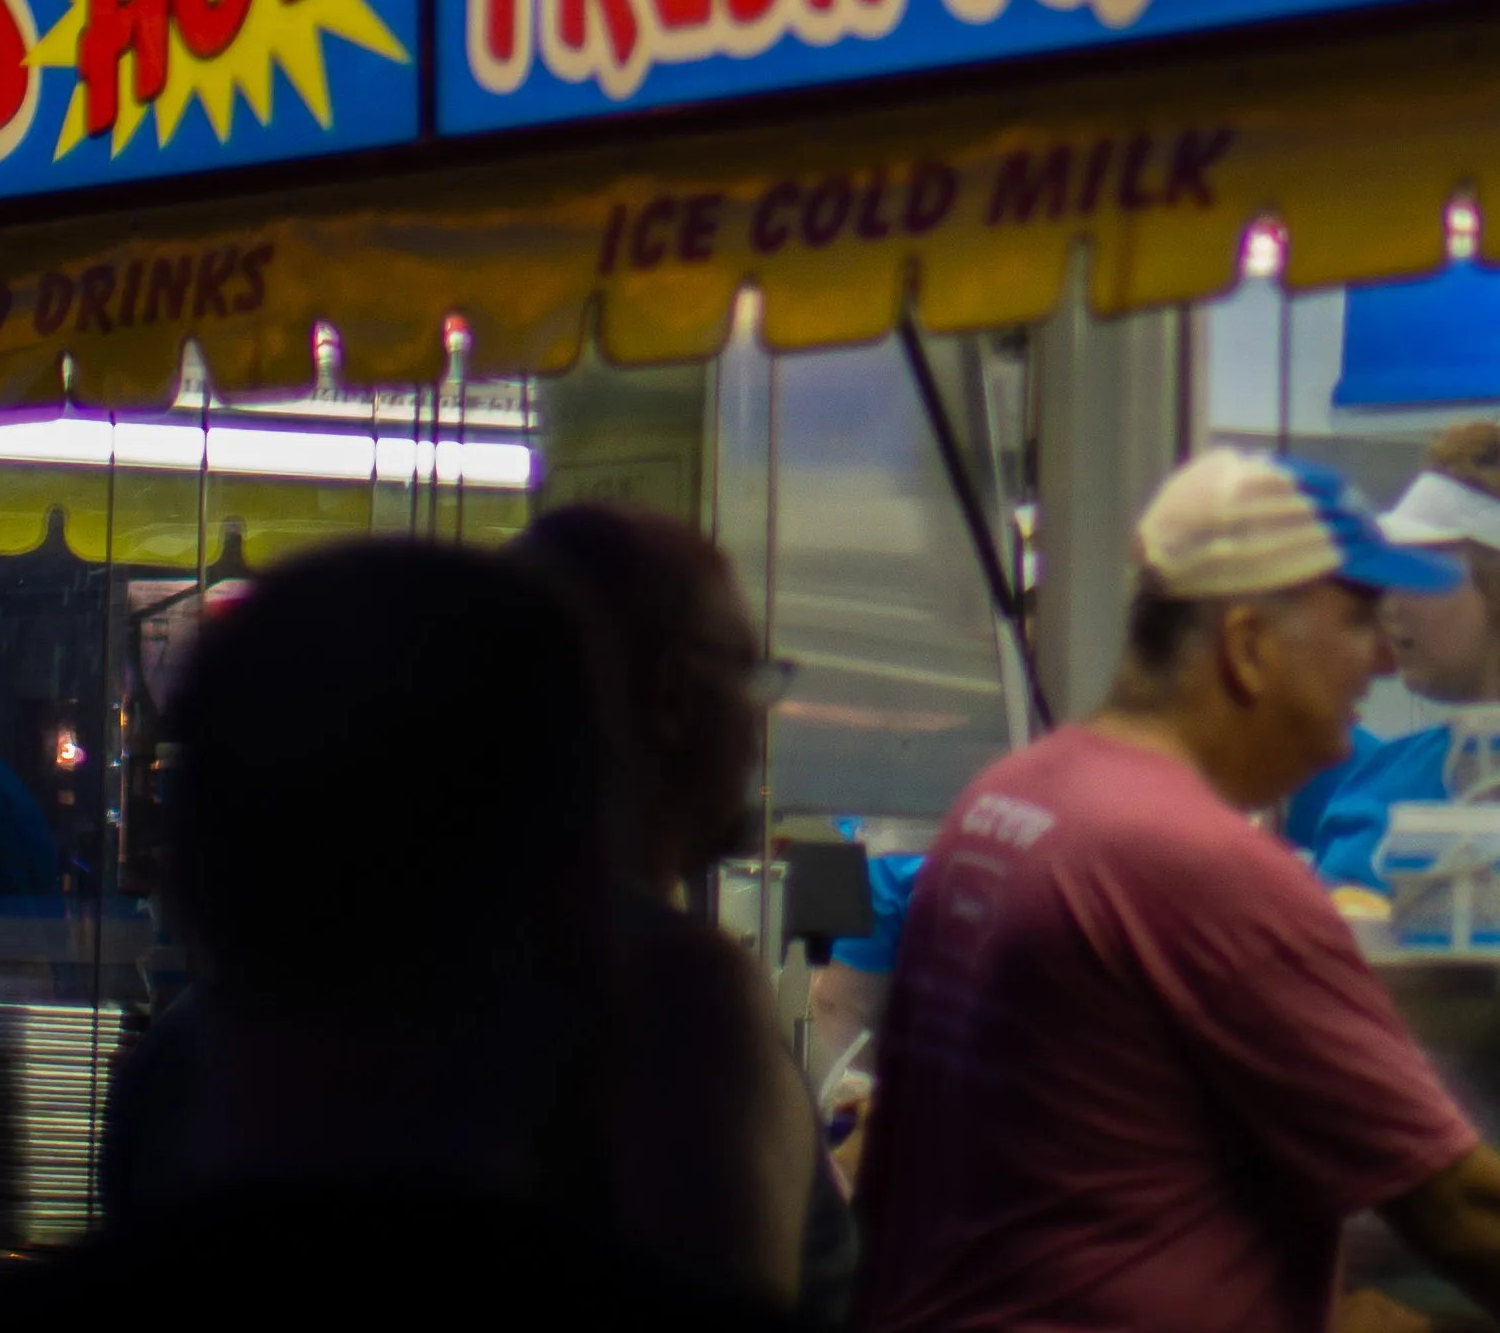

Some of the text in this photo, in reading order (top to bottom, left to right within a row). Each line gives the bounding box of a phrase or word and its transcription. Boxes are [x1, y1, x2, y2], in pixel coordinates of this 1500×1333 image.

[600, 128, 1240, 276] ICE COLD MILK
[32, 243, 275, 335] DRINKS
